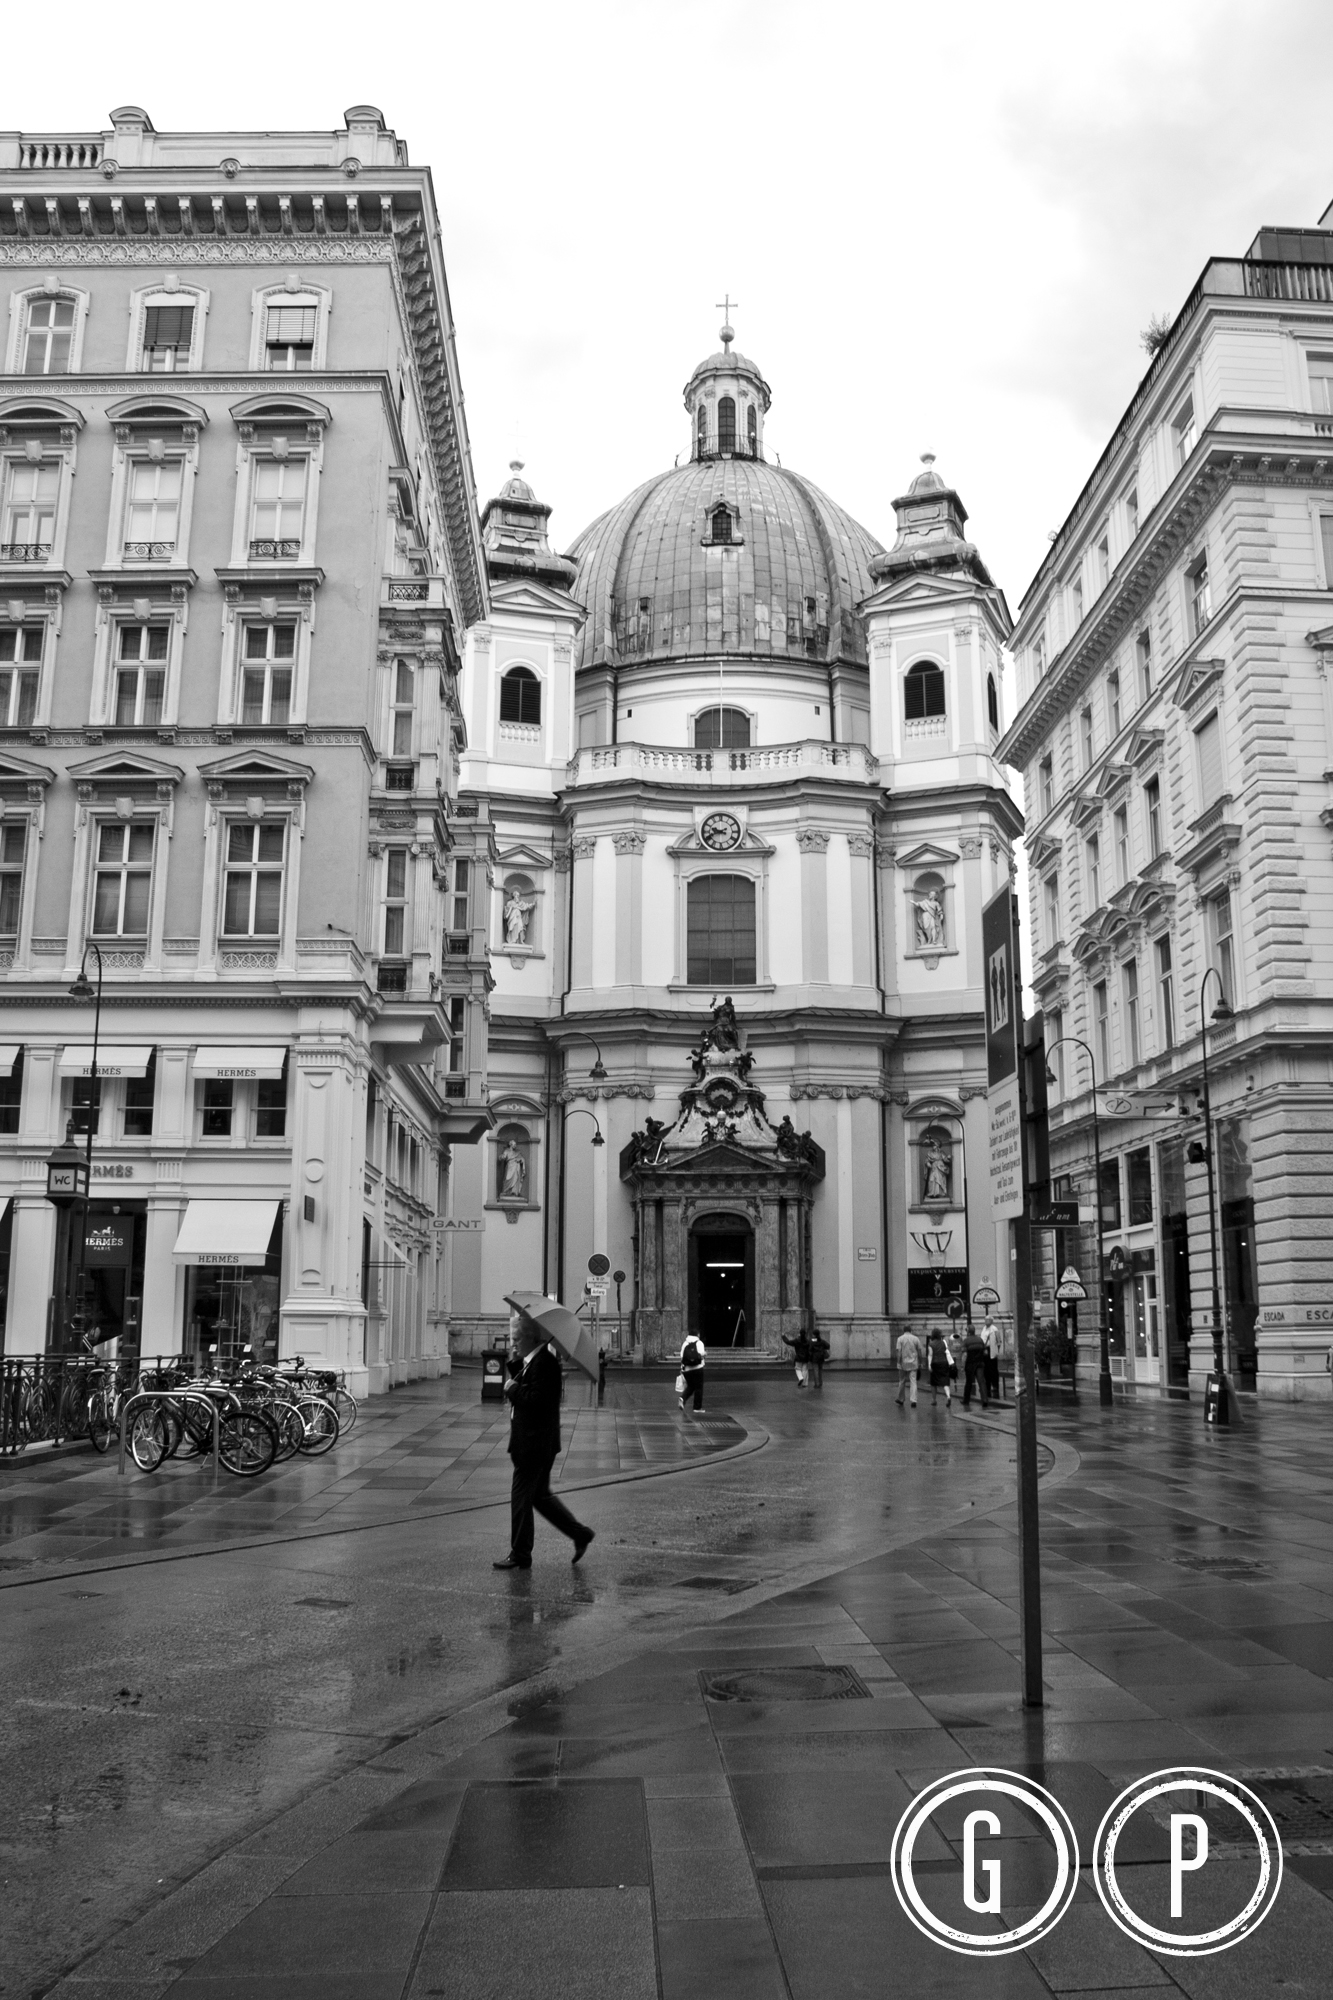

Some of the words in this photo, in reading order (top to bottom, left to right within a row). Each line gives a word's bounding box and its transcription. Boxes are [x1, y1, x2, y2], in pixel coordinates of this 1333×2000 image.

[82, 1066, 121, 1075] HRMÈS
[92, 1164, 133, 1178] RMÈS
[54, 1175, 71, 1185] WC
[433, 1220, 481, 1228] GANT
[1263, 1311, 1285, 1322] ESCADA
